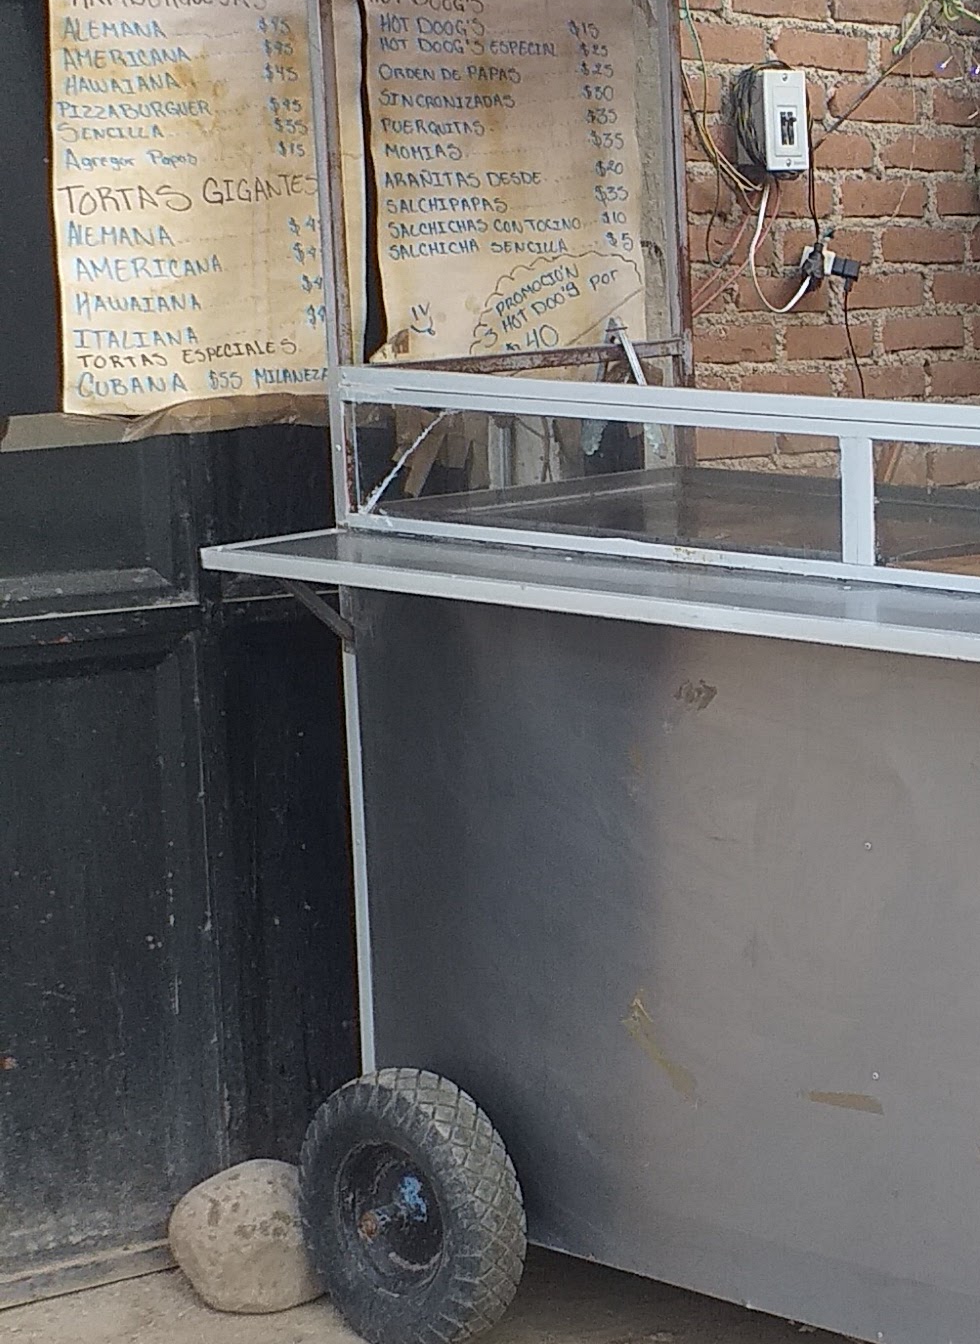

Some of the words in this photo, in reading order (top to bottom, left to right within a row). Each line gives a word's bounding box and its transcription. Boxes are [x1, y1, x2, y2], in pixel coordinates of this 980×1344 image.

[62, 16, 168, 42] ALEMANA
[379, 13, 409, 34] HOT
[379, 37, 408, 53] HOT
[489, 40, 558, 57] ESPECIAL
[62, 47, 192, 71] AMERICANA
[64, 72, 182, 97] HAWAIANA
[264, 63, 299, 82] $45
[378, 62, 436, 81] ORDEN
[441, 68, 461, 81] DE
[467, 65, 522, 84] PAPAS
[57, 100, 212, 120] PIZZABURGUER
[378, 88, 516, 109] SINCRONIZADAS
[56, 122, 165, 143] SENCILLA
[380, 117, 486, 137] PUERQUITAS
[64, 148, 136, 171] Agregar
[384, 142, 463, 161] MOMIAS
[384, 170, 481, 190] ARAÑITAS
[486, 171, 542, 188] DESDE
[58, 184, 192, 216] TORTAS
[386, 197, 509, 216] SALCHIPAPAS
[67, 220, 176, 247] ALEMANA
[387, 217, 489, 240] SALCHICHAS
[493, 218, 524, 234] CON
[527, 216, 582, 233] TOCINO
[388, 238, 480, 261] SALCHICHA
[490, 239, 570, 254] SENCILLA
[75, 254, 223, 282] AMERICANA
[74, 292, 202, 321] HAWAIANA
[502, 308, 535, 334] HOT
[73, 326, 199, 349] ITALIANA
[525, 322, 560, 350] 40
[77, 353, 169, 370] TORTAS
[182, 338, 299, 364] ESPECIALES
[77, 371, 189, 398] CUBANA
